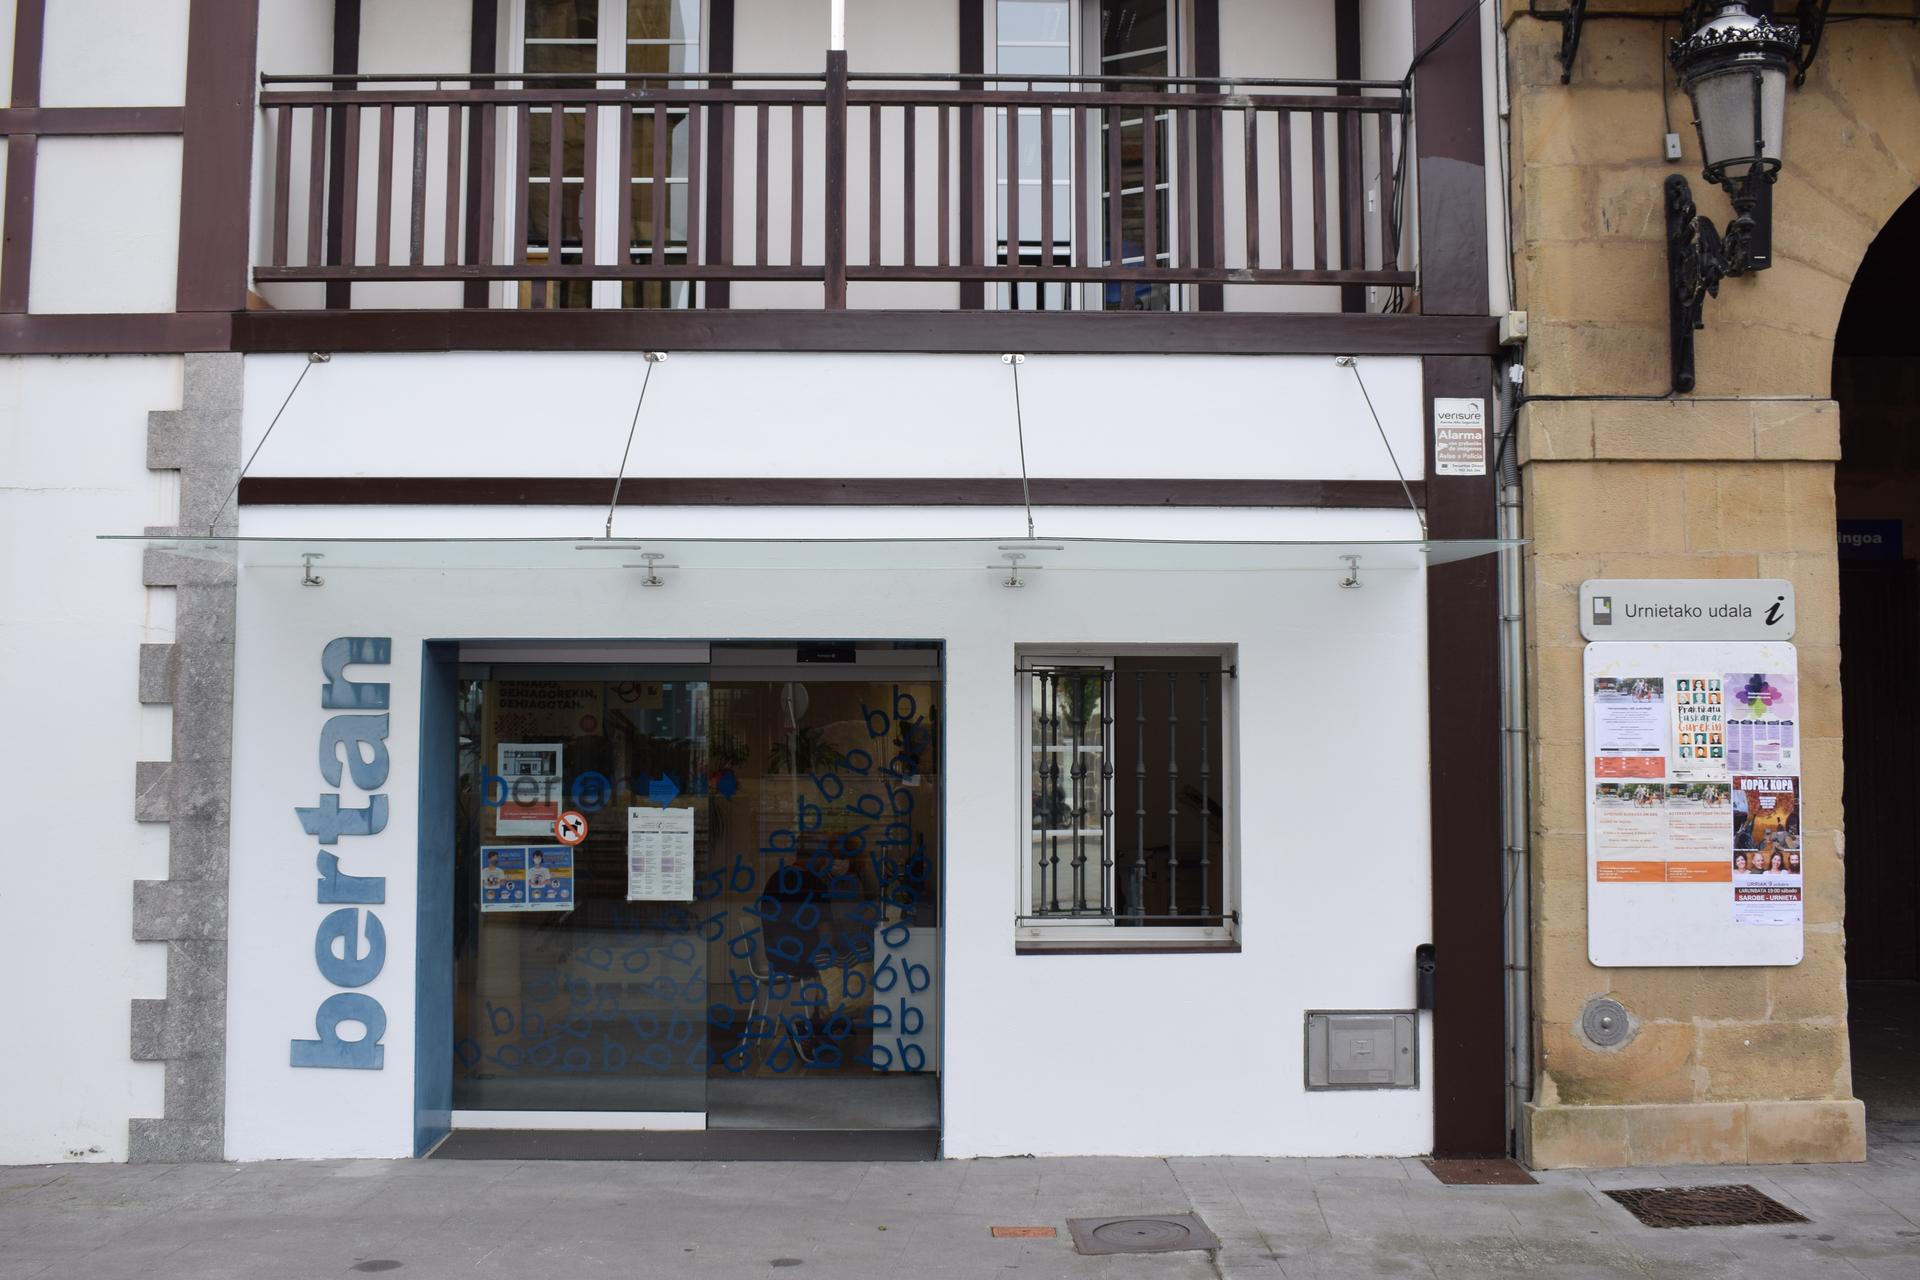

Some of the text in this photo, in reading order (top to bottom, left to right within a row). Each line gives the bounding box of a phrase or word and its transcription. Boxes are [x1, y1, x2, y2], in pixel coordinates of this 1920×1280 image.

[1438, 412, 1481, 420] verisure
[1439, 430, 1481, 439] Alarma
[1625, 603, 1702, 618] Urnietako
[1709, 603, 1752, 618] udala
[1678, 706, 1720, 714] Praktikatu
[1741, 779, 1792, 790] KOPAZ KOPA
[290, 636, 392, 1070] bertan
